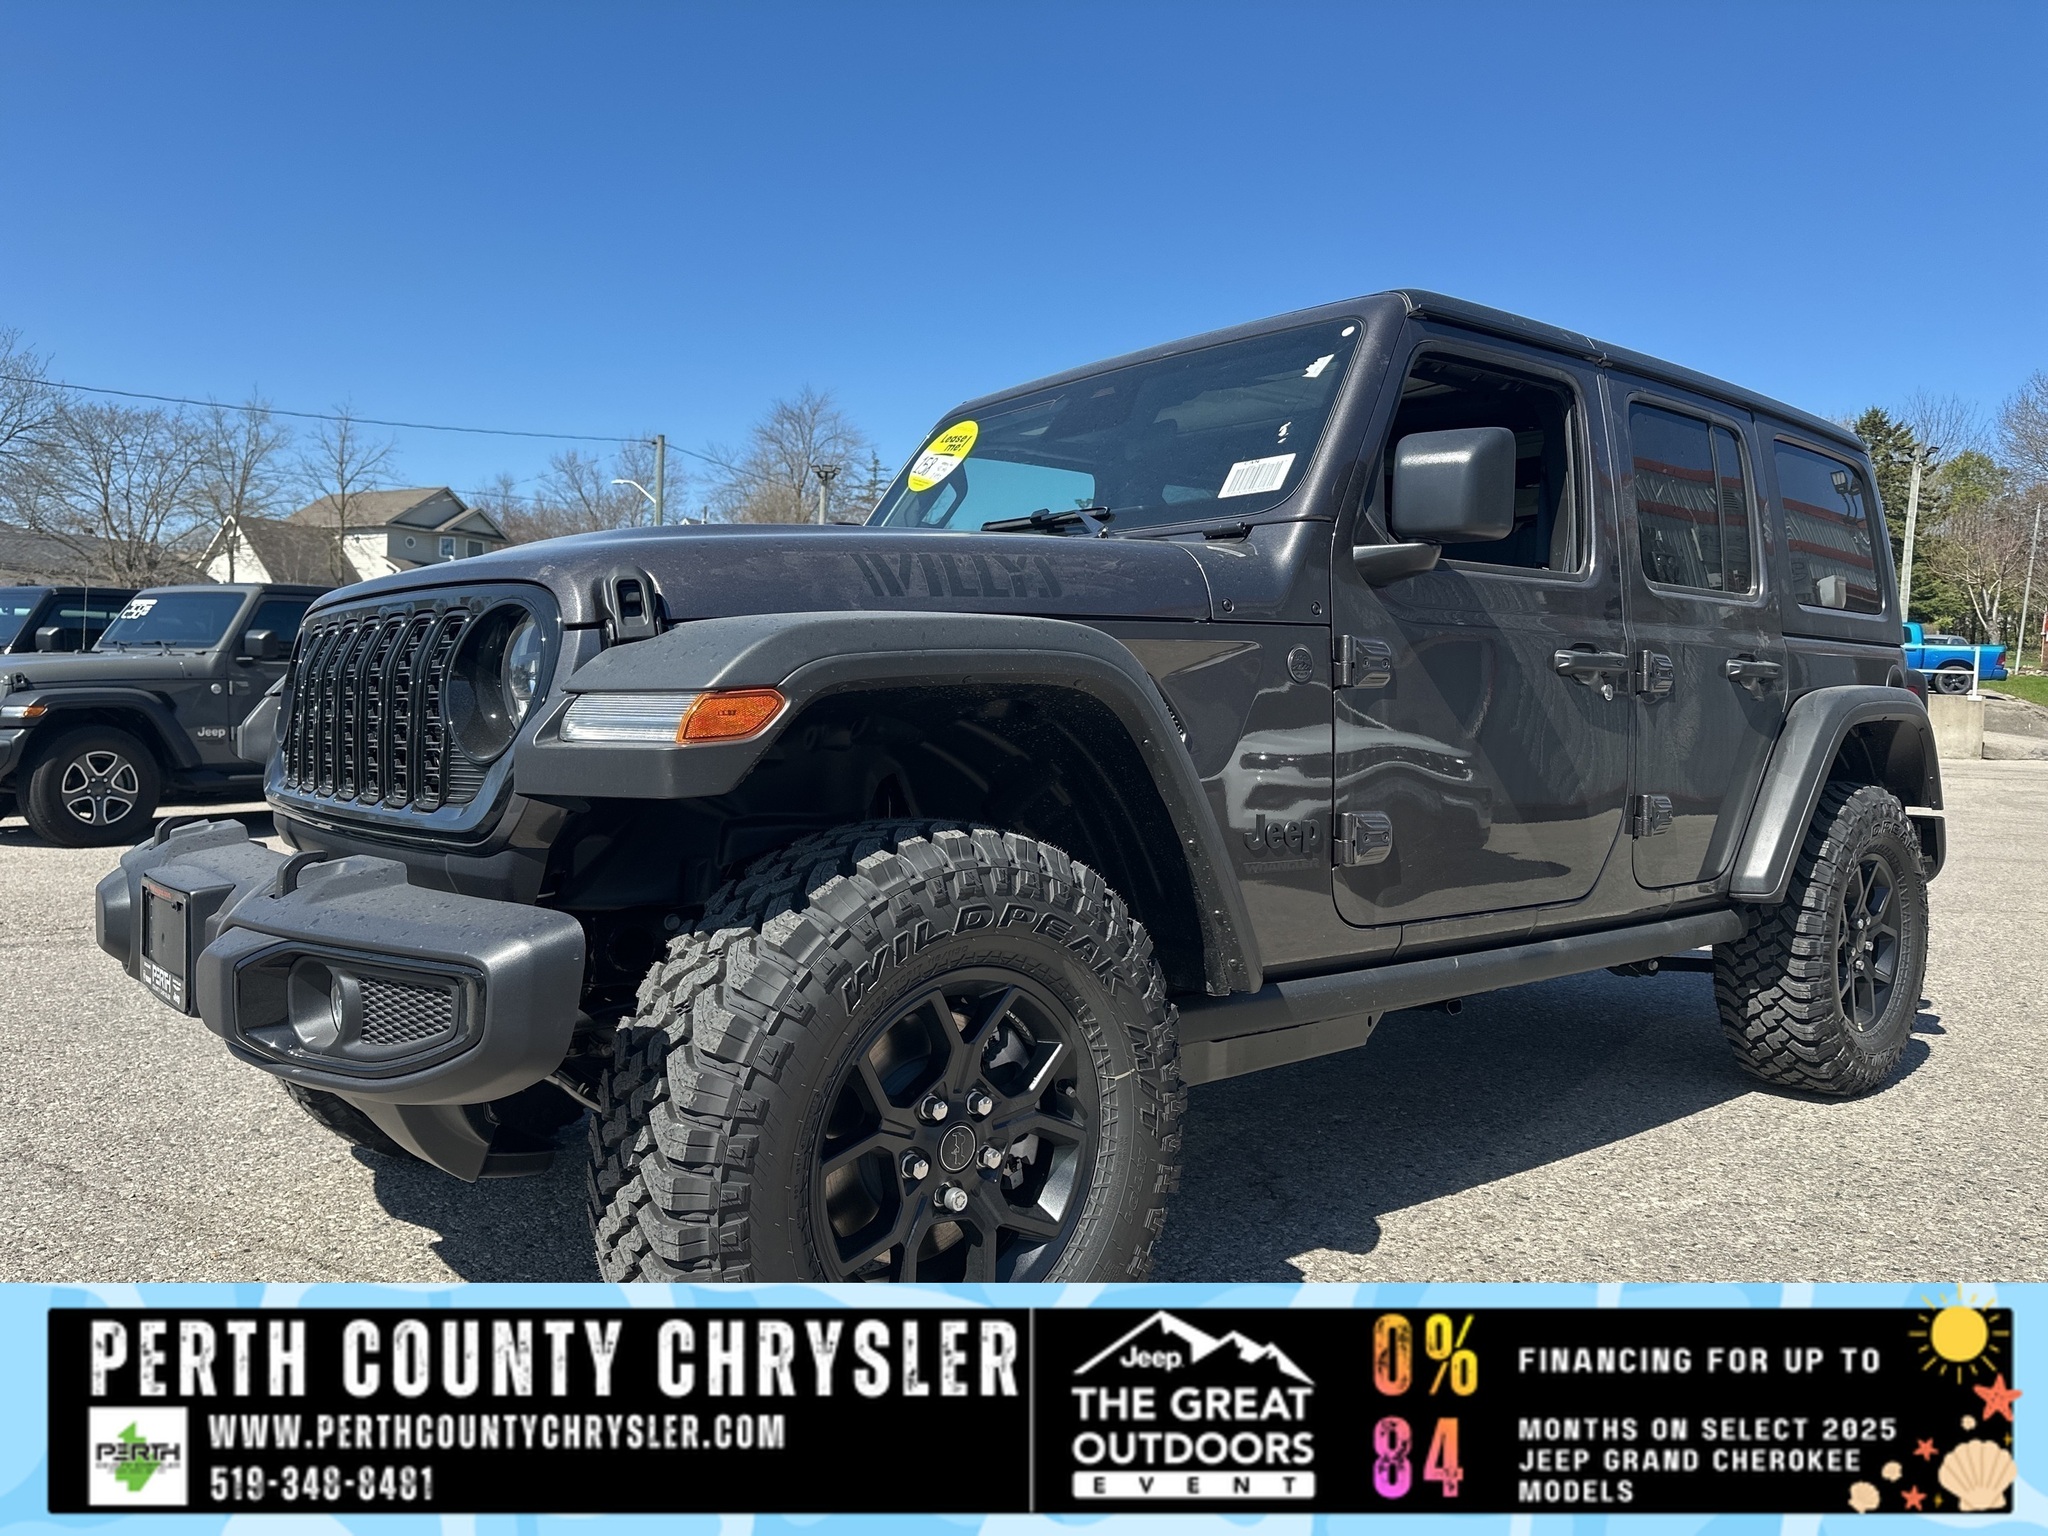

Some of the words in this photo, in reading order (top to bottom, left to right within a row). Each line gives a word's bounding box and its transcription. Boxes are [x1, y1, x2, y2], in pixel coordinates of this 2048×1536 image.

[197, 726, 226, 738] Jeep
[1243, 813, 1320, 853] Jeep
[840, 902, 1126, 1017] WILDPEAK
